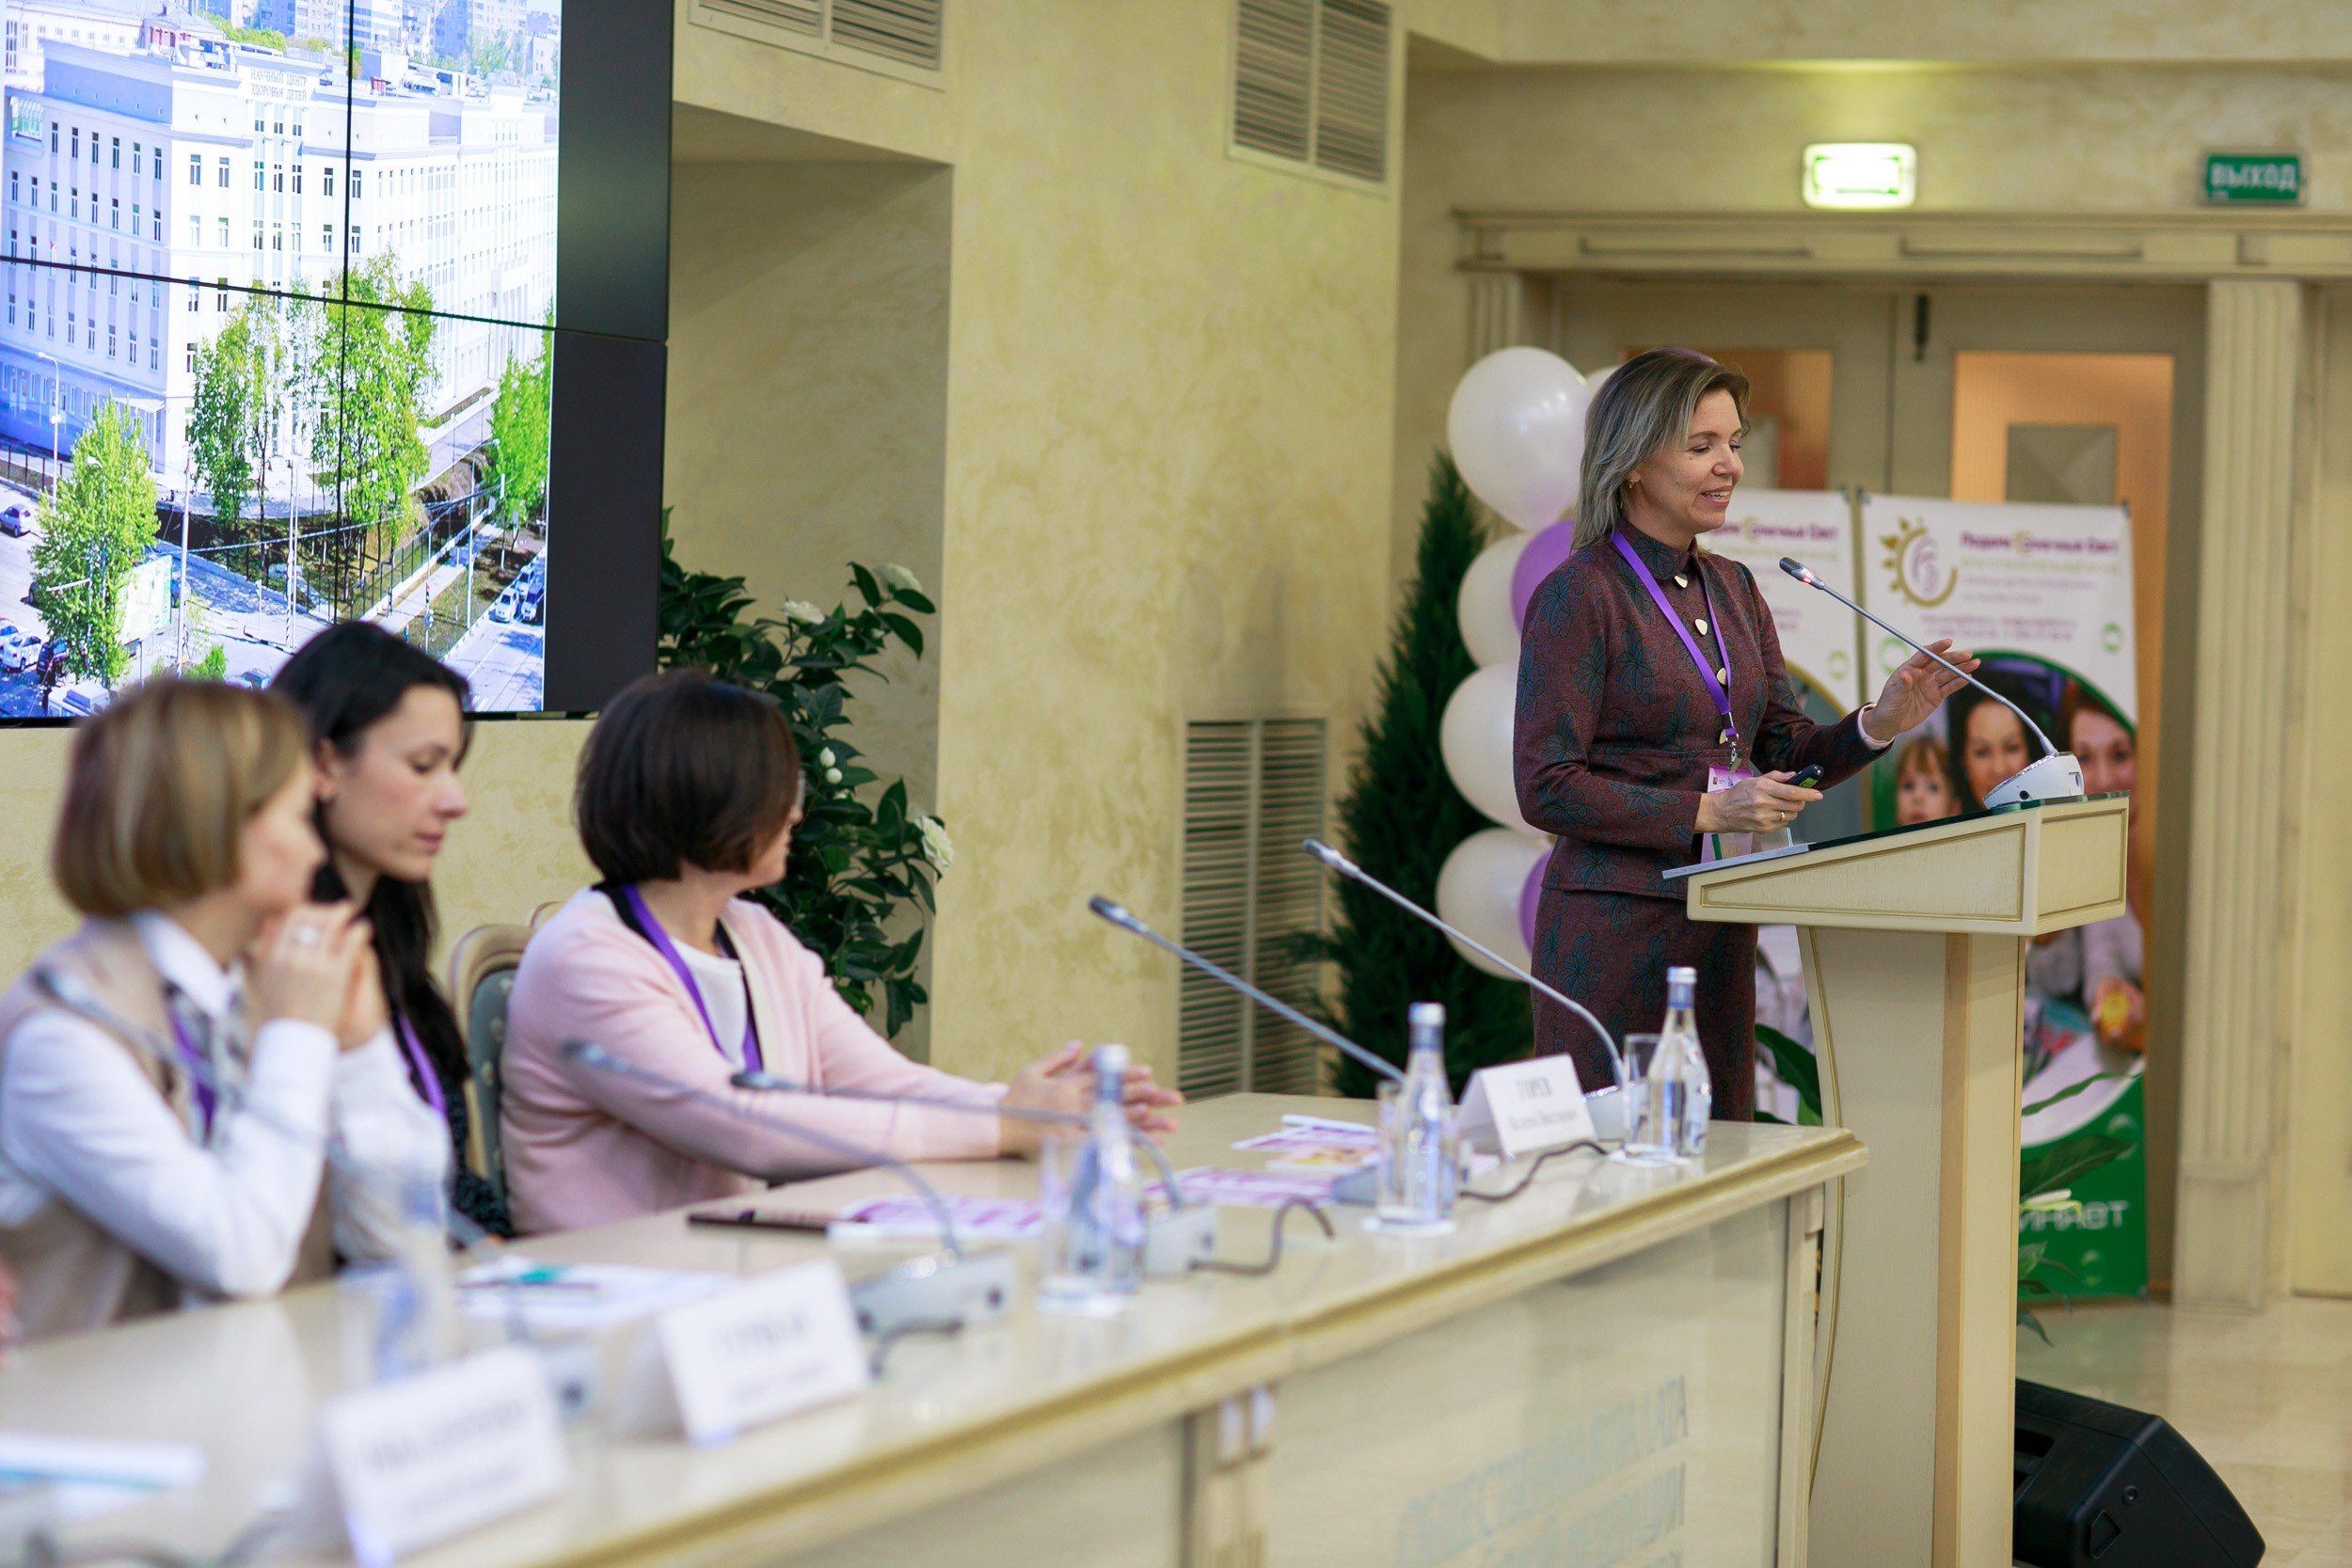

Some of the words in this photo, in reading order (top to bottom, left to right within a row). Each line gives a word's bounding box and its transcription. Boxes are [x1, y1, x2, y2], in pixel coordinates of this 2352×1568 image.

[250, 68, 284, 84] НАУЧНЫЙ
[286, 73, 308, 87] ЦЕНТР
[250, 83, 284, 99] ЗДОРОВЬЯ
[286, 88, 308, 103] ДЕТЕЙ
[2211, 162, 2296, 193] ВЫХОД
